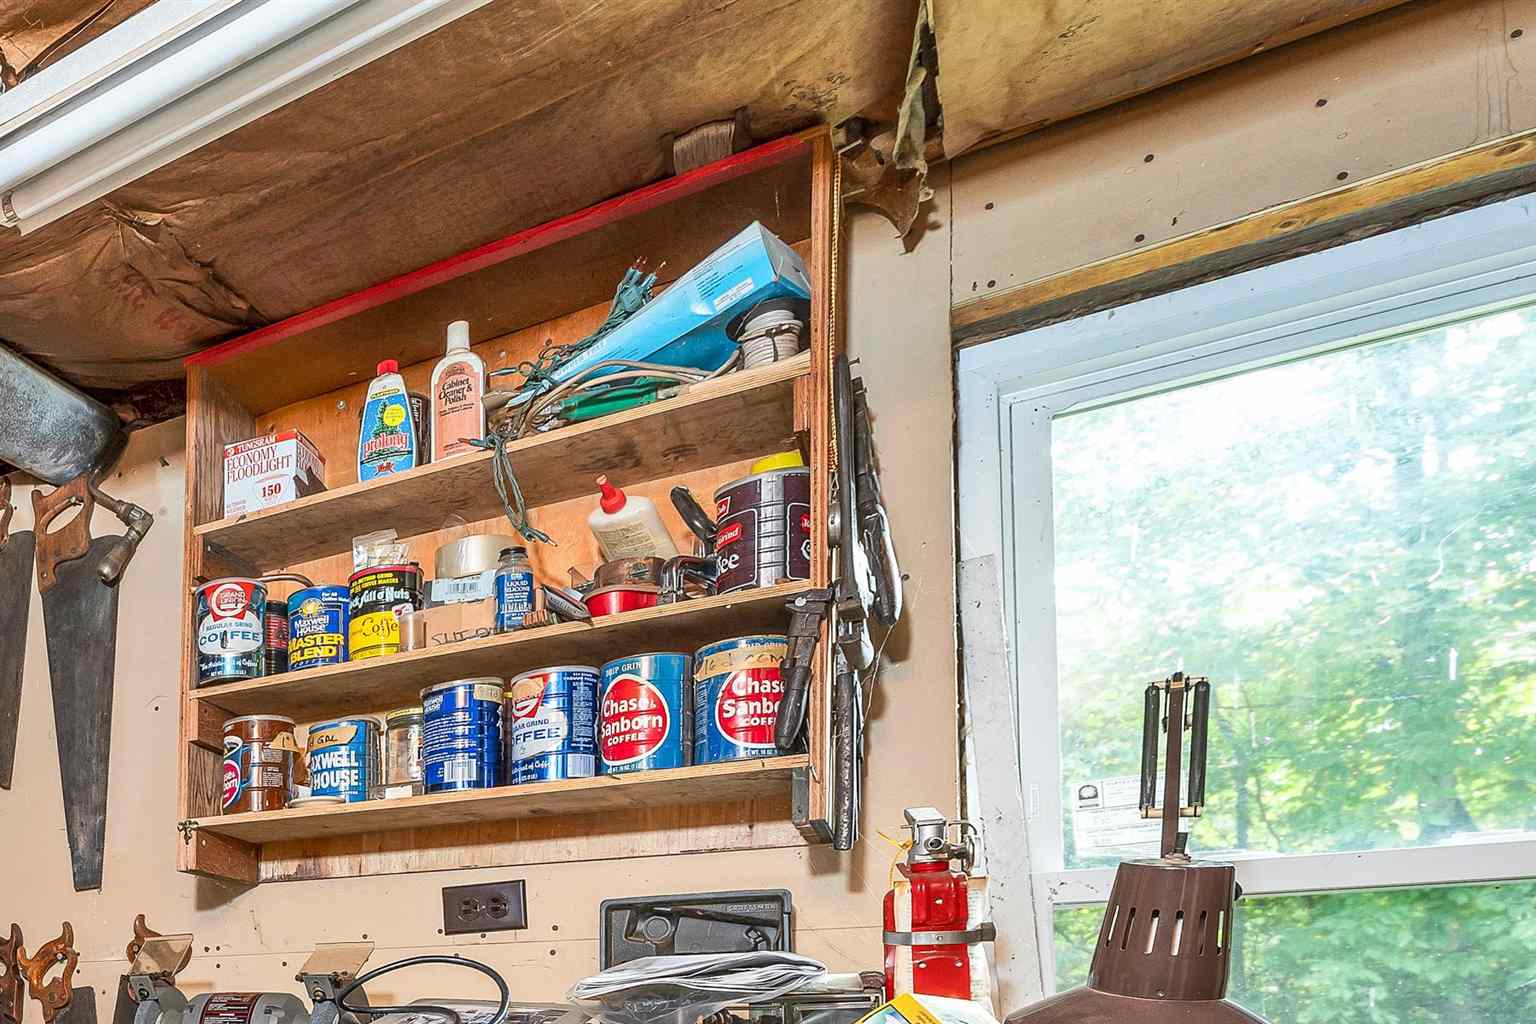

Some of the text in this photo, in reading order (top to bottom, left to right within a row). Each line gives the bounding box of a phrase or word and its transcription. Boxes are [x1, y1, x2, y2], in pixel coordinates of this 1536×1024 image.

[363, 432, 409, 458] prolong
[226, 445, 278, 472] ECONOMY
[226, 454, 293, 485] FLOODLIGHT
[261, 482, 282, 498] 150
[294, 614, 329, 630] Maxwell
[361, 616, 399, 638] Coffe
[288, 632, 345, 652] MASTER
[290, 645, 338, 664] BLEND
[621, 661, 642, 673] GRIN
[722, 695, 780, 719] Sanb
[602, 713, 664, 737] Sanborn
[743, 716, 776, 727] COFF
[514, 727, 561, 745] FFEE
[607, 731, 648, 747] COFFEE
[313, 772, 361, 790] HOUSE
